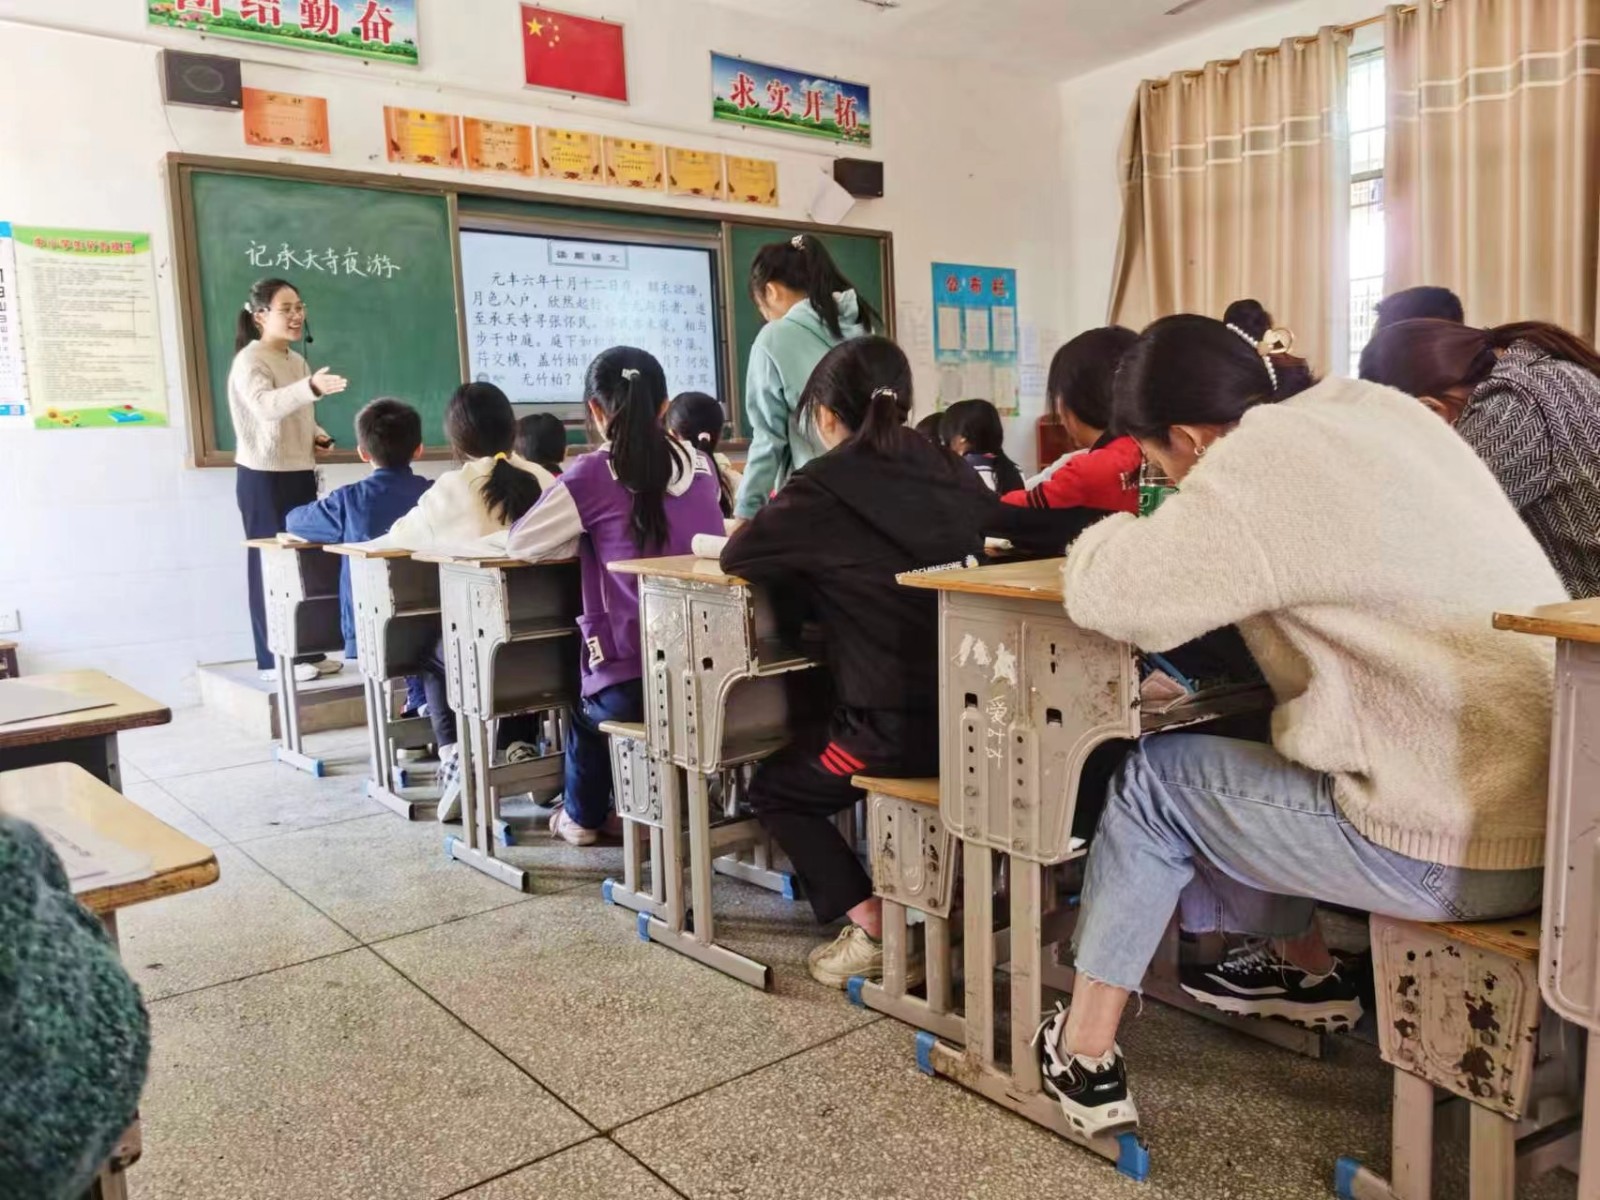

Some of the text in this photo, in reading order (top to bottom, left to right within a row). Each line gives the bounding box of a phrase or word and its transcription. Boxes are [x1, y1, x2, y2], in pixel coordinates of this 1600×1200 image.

[730, 73, 857, 128] 求实开拓
[244, 240, 401, 279] 记承天寺夜游
[945, 274, 1005, 297] 公布栏
